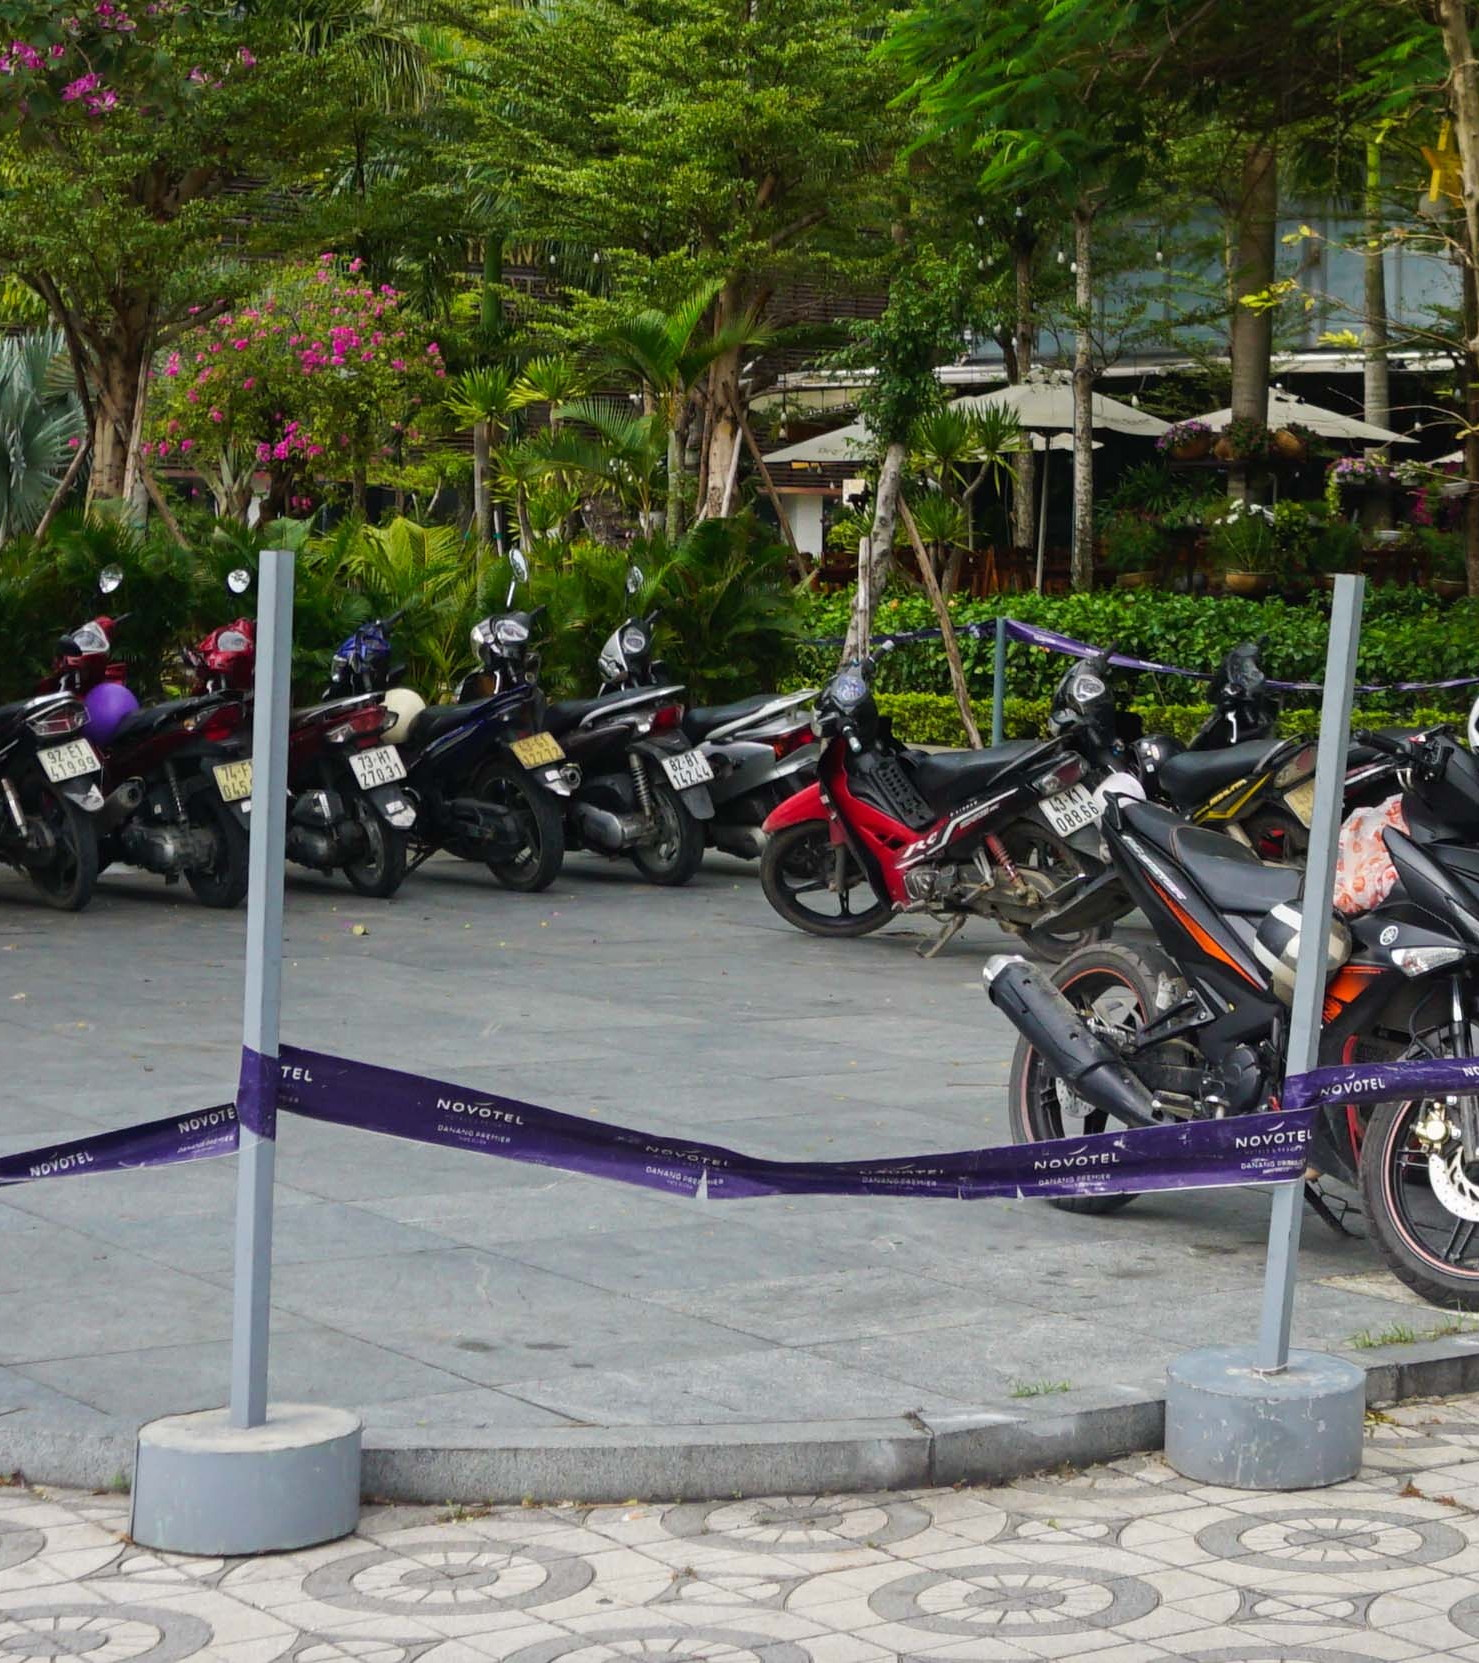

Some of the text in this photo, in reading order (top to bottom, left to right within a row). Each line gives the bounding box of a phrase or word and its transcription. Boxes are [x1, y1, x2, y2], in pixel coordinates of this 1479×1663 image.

[360, 762, 403, 787] 270.31
[672, 765, 711, 789] 142.44
[1055, 801, 1100, 833] 088.66
[1321, 1077, 1387, 1096] NOVOTEL
[177, 1106, 236, 1135] NOVOTE
[436, 1098, 524, 1126] NOVOTEL
[437, 1123, 475, 1138] DANANG
[1235, 1129, 1313, 1149] NOVOTEL
[29, 1151, 95, 1178] NOVOTEL
[646, 1144, 731, 1168] NOVOTEL
[1034, 1152, 1121, 1171] NOVOTEL
